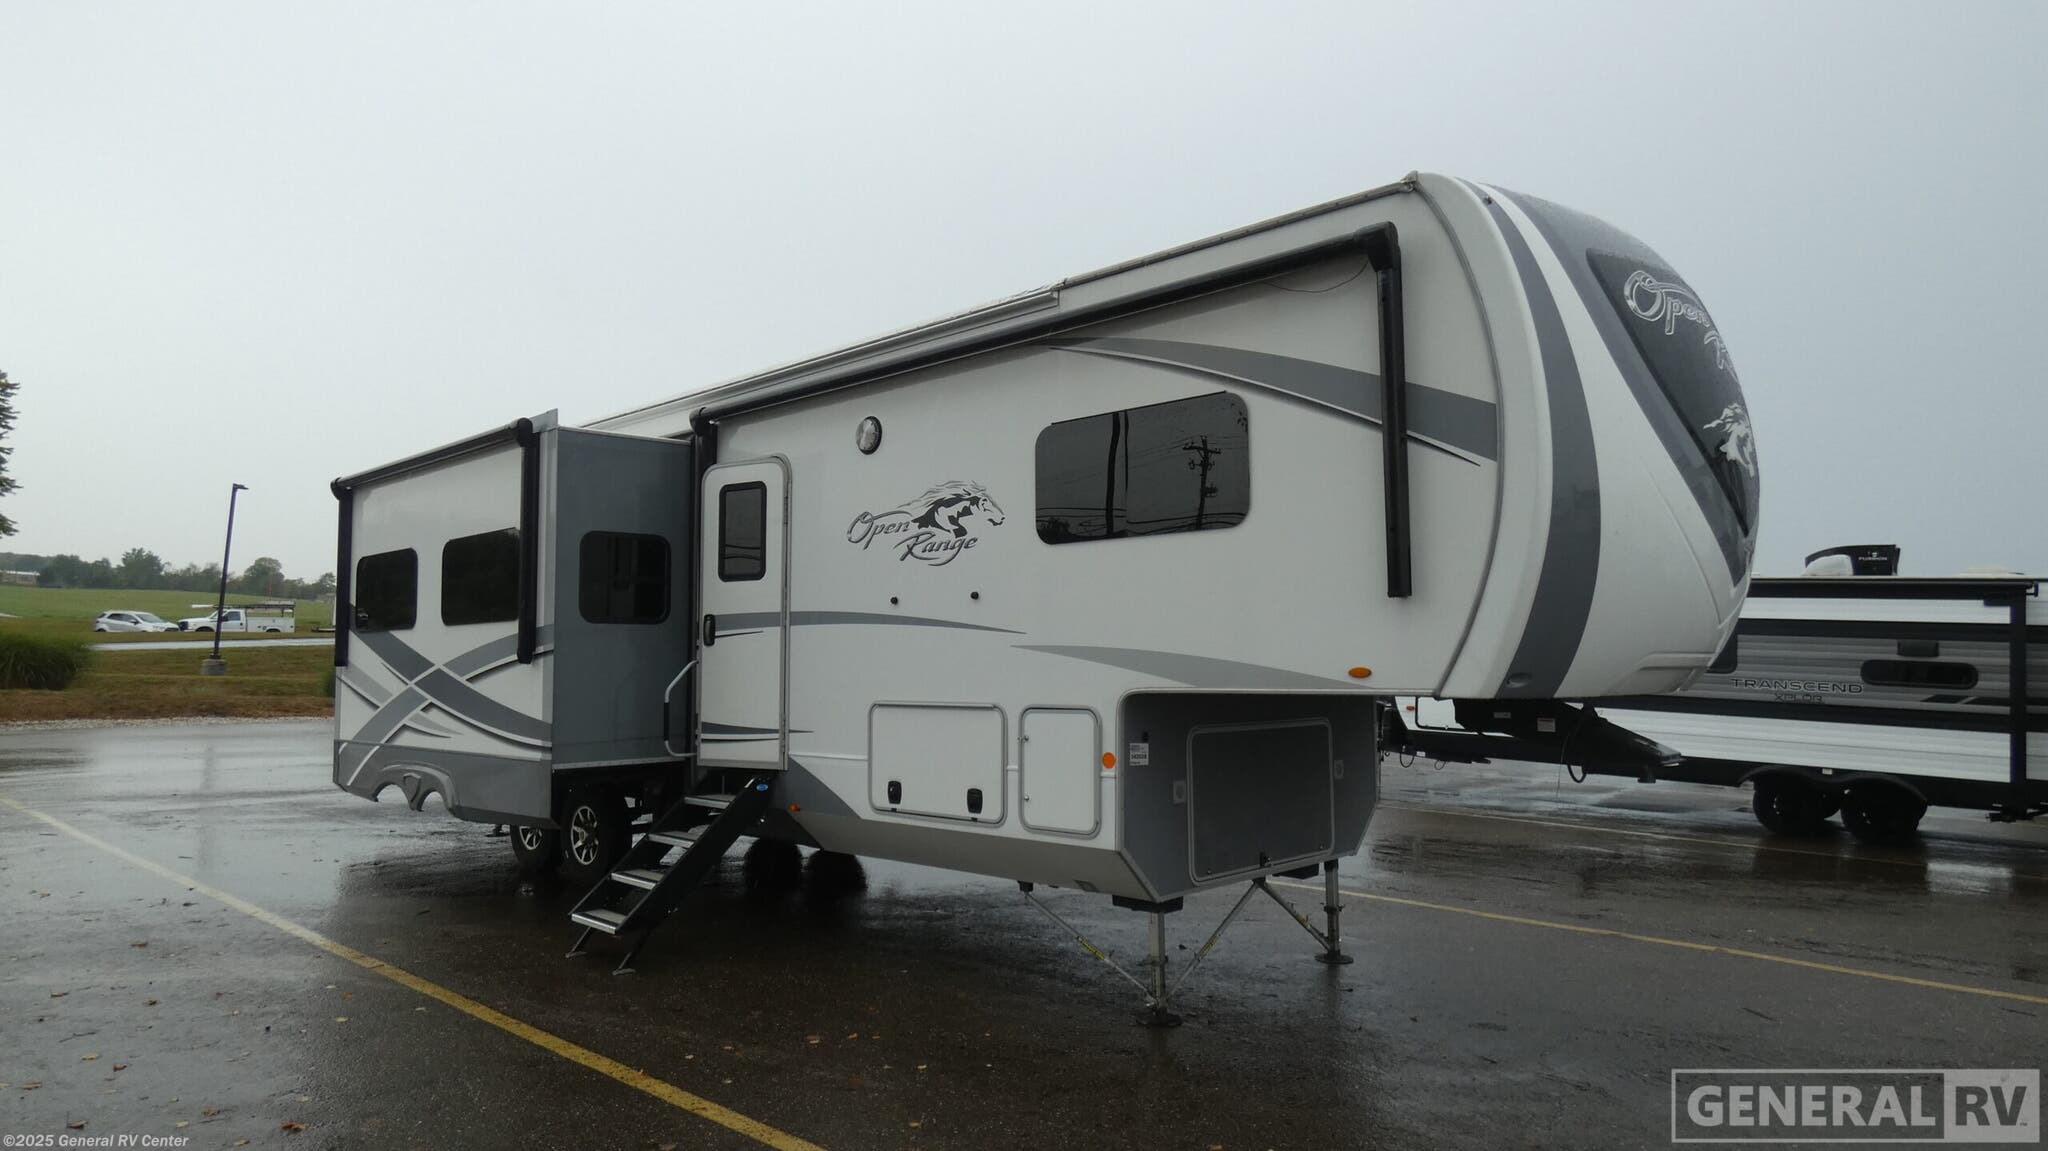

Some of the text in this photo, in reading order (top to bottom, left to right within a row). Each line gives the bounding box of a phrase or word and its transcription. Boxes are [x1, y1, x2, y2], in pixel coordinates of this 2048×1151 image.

[1623, 269, 1710, 335] Open
[847, 511, 912, 550] Open
[893, 530, 978, 567] Range
[1730, 678, 1863, 694] TRANSCEND
